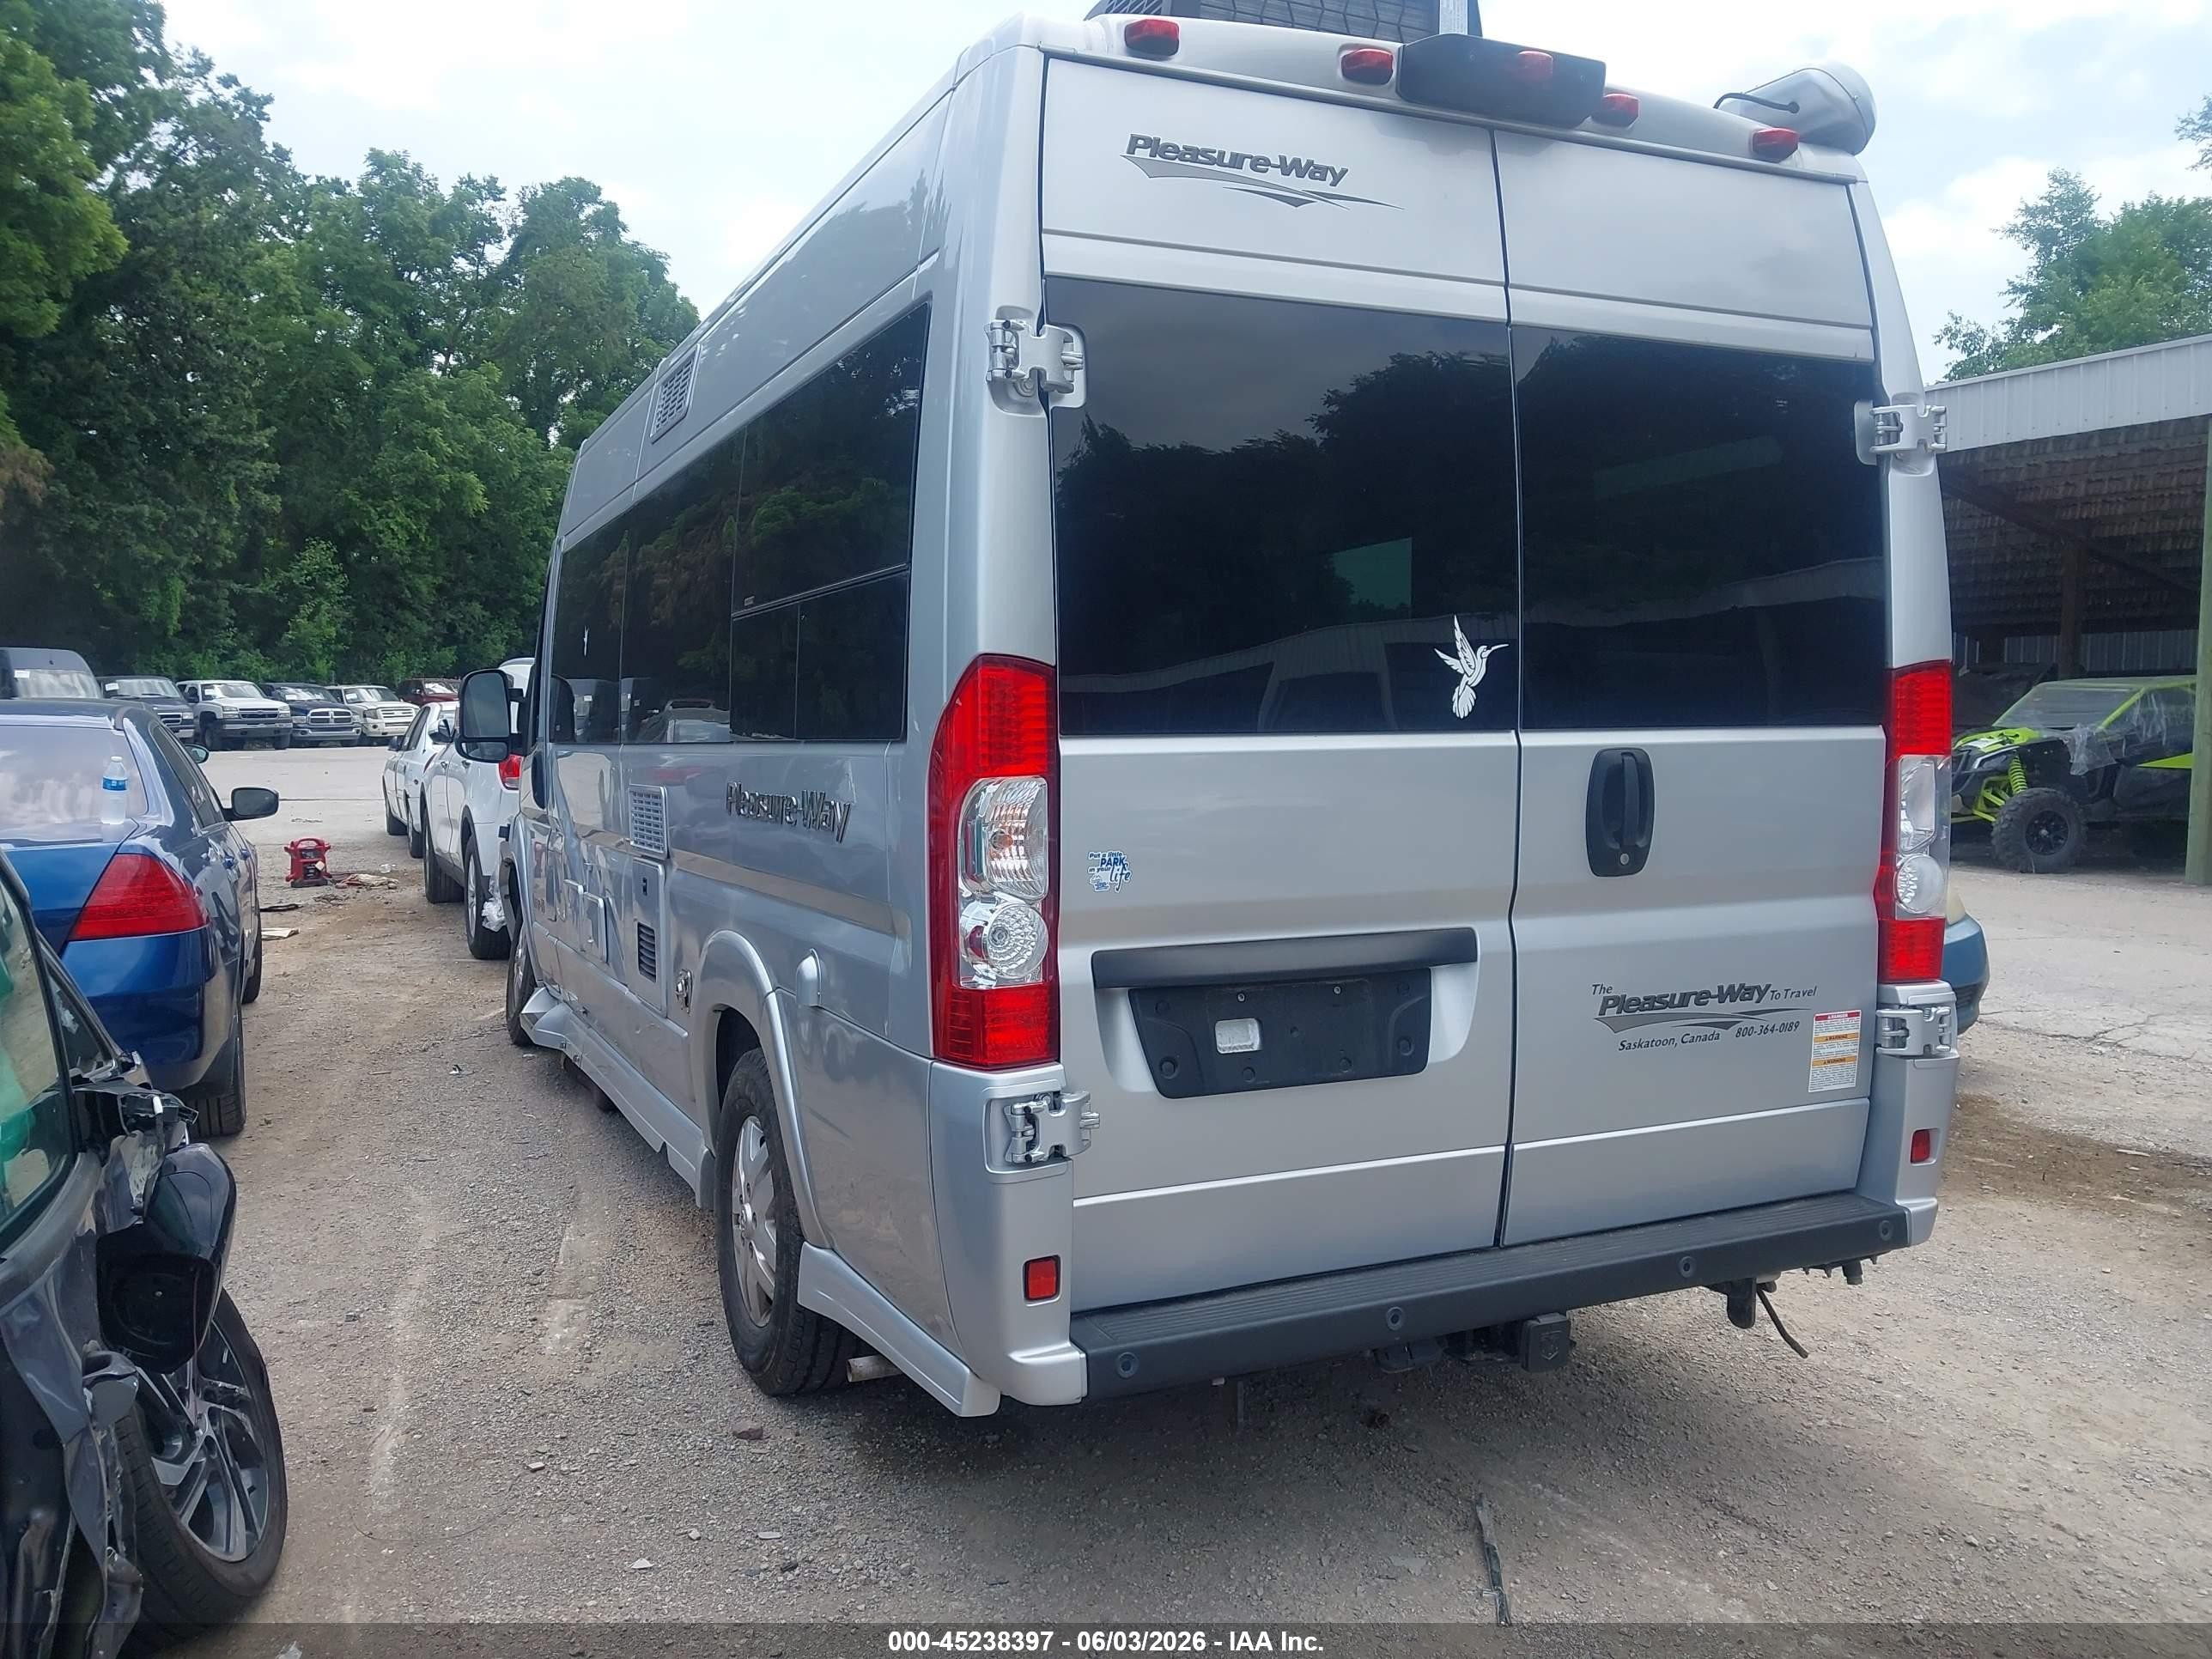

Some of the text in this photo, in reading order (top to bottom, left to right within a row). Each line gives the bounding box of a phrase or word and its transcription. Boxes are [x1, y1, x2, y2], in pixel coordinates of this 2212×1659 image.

[1126, 133, 1349, 187] Pleasure-Way
[726, 781, 851, 843] Pleasure-Way
[1100, 856, 1127, 867] PARK
[1110, 863, 1130, 890] life
[1591, 983, 1818, 1015] The Pleasure-Way To Travel
[1618, 1030, 1721, 1052] Saskatoon, Canada
[1735, 1020, 1800, 1038] 800-364-0189
